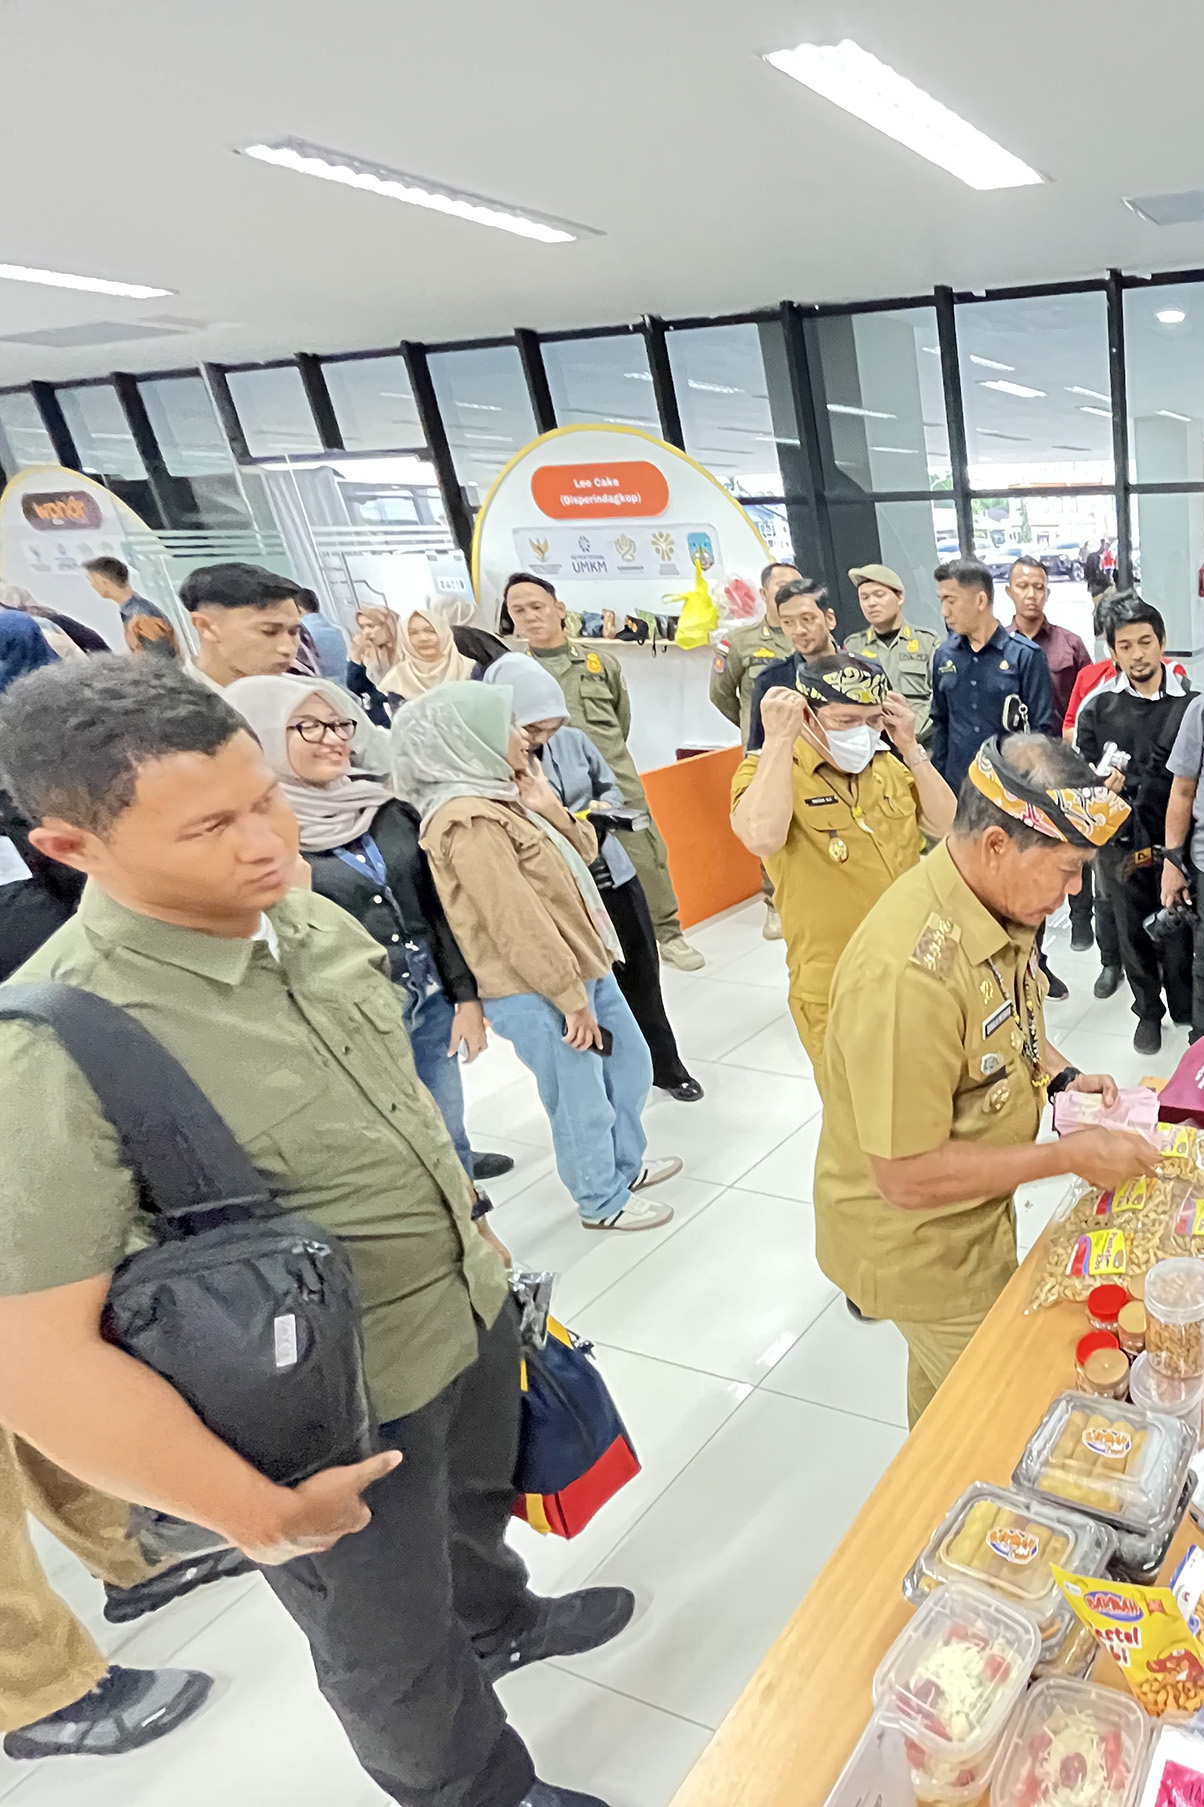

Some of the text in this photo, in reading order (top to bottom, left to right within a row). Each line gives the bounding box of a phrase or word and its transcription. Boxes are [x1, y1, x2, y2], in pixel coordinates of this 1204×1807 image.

[573, 477, 619, 489] Lee Cake
[560, 492, 641, 506] (Disperindagkop)
[572, 561, 608, 573] UMKM
[1095, 1626, 1139, 1646] astel
[1109, 1645, 1128, 1665] bi
